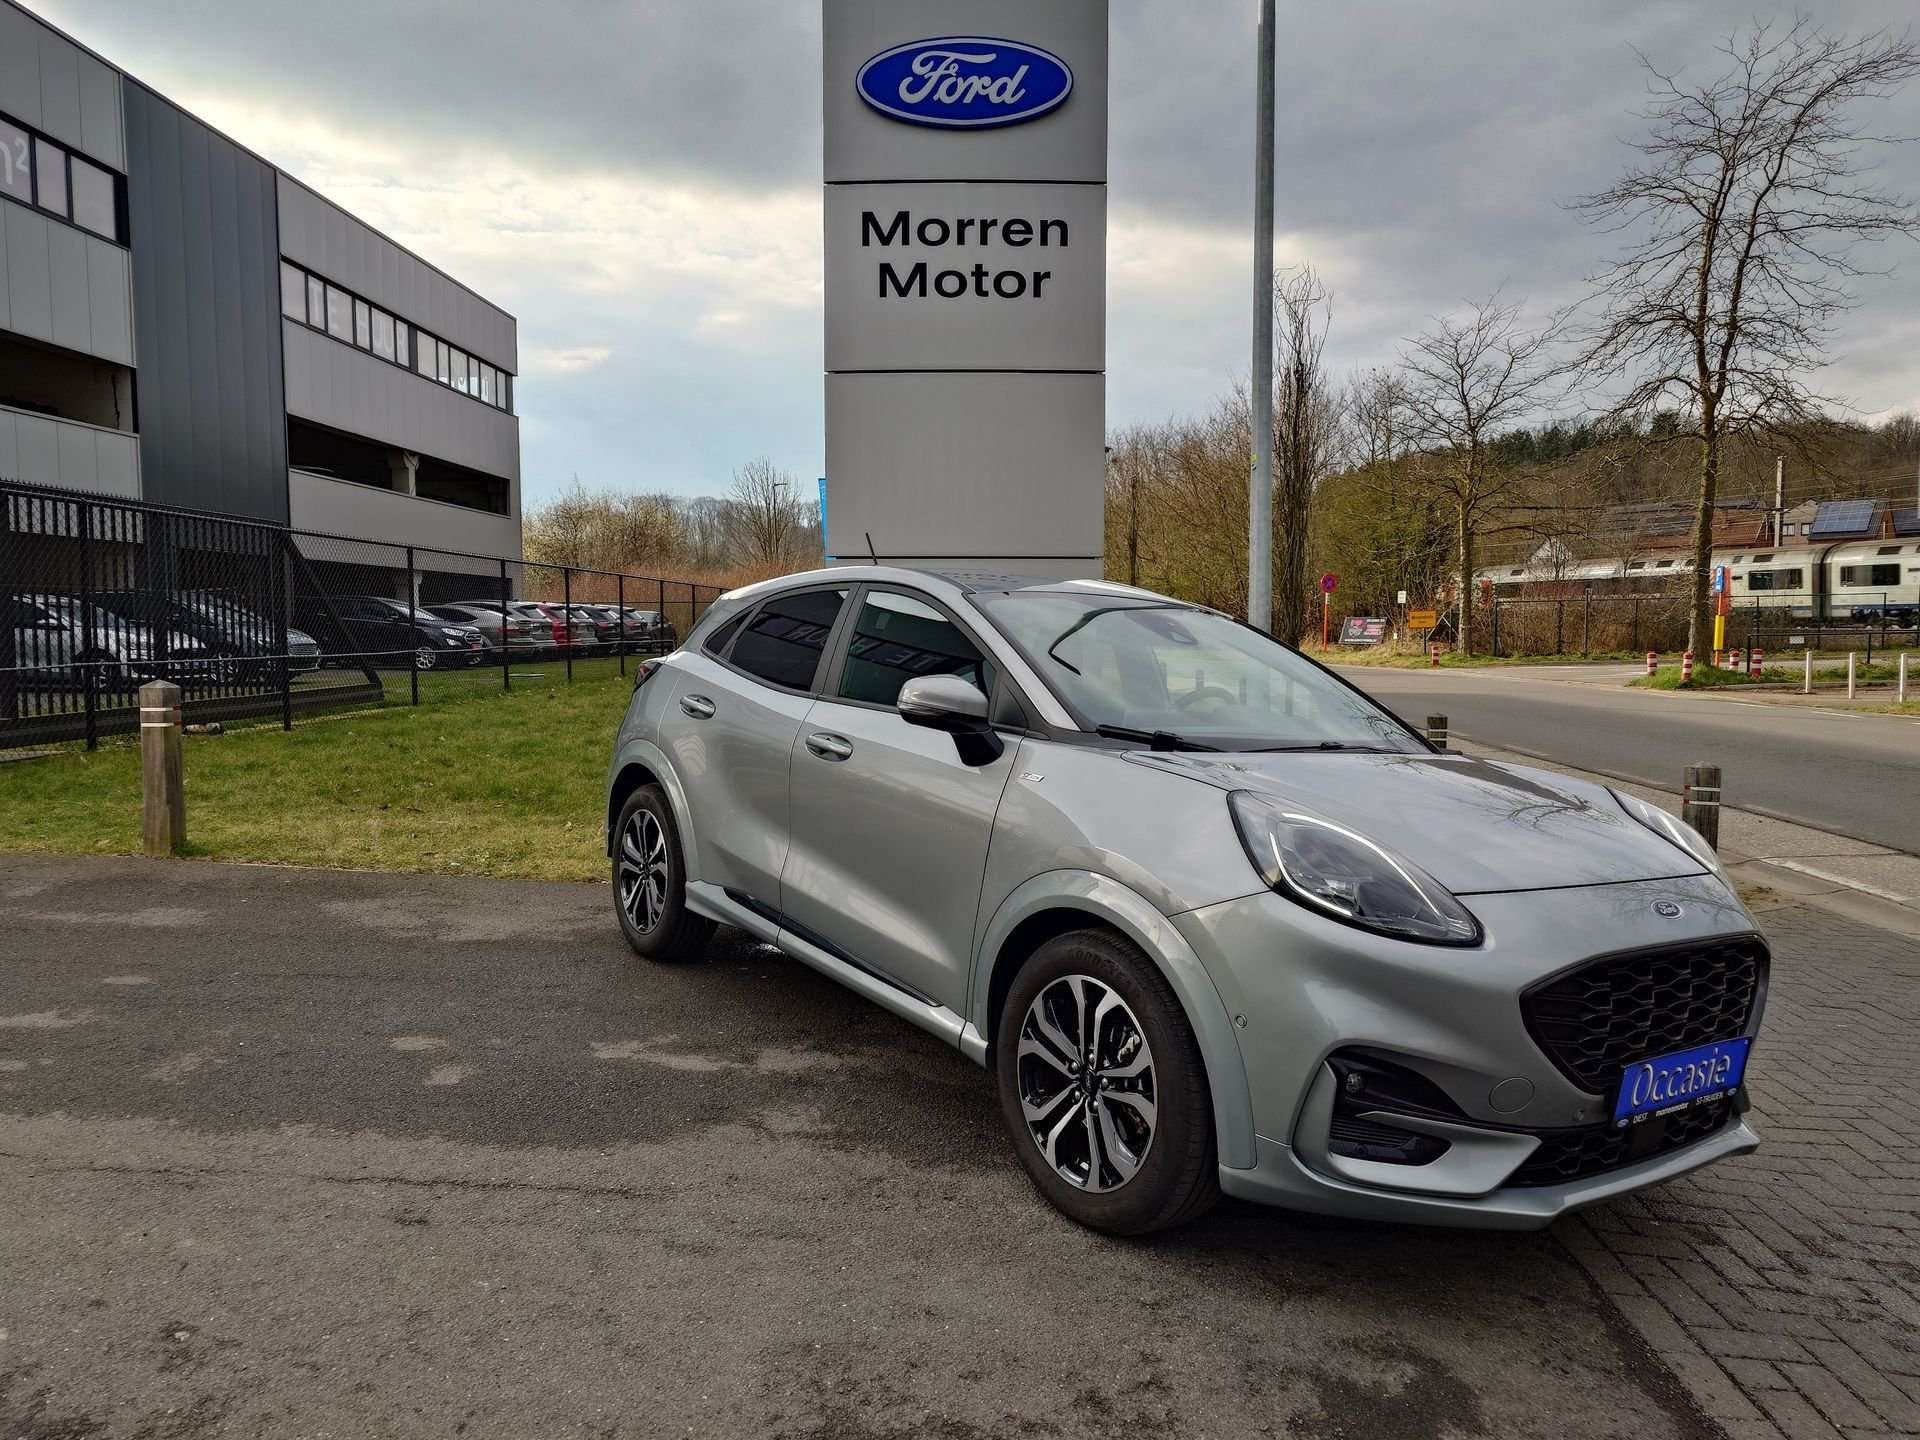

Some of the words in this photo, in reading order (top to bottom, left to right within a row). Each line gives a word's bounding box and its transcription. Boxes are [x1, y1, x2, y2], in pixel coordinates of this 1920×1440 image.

[899, 50, 1029, 104] Ford
[861, 210, 1069, 248] Morren
[879, 262, 1051, 299] Motor
[1632, 1047, 1731, 1106] Occasie
